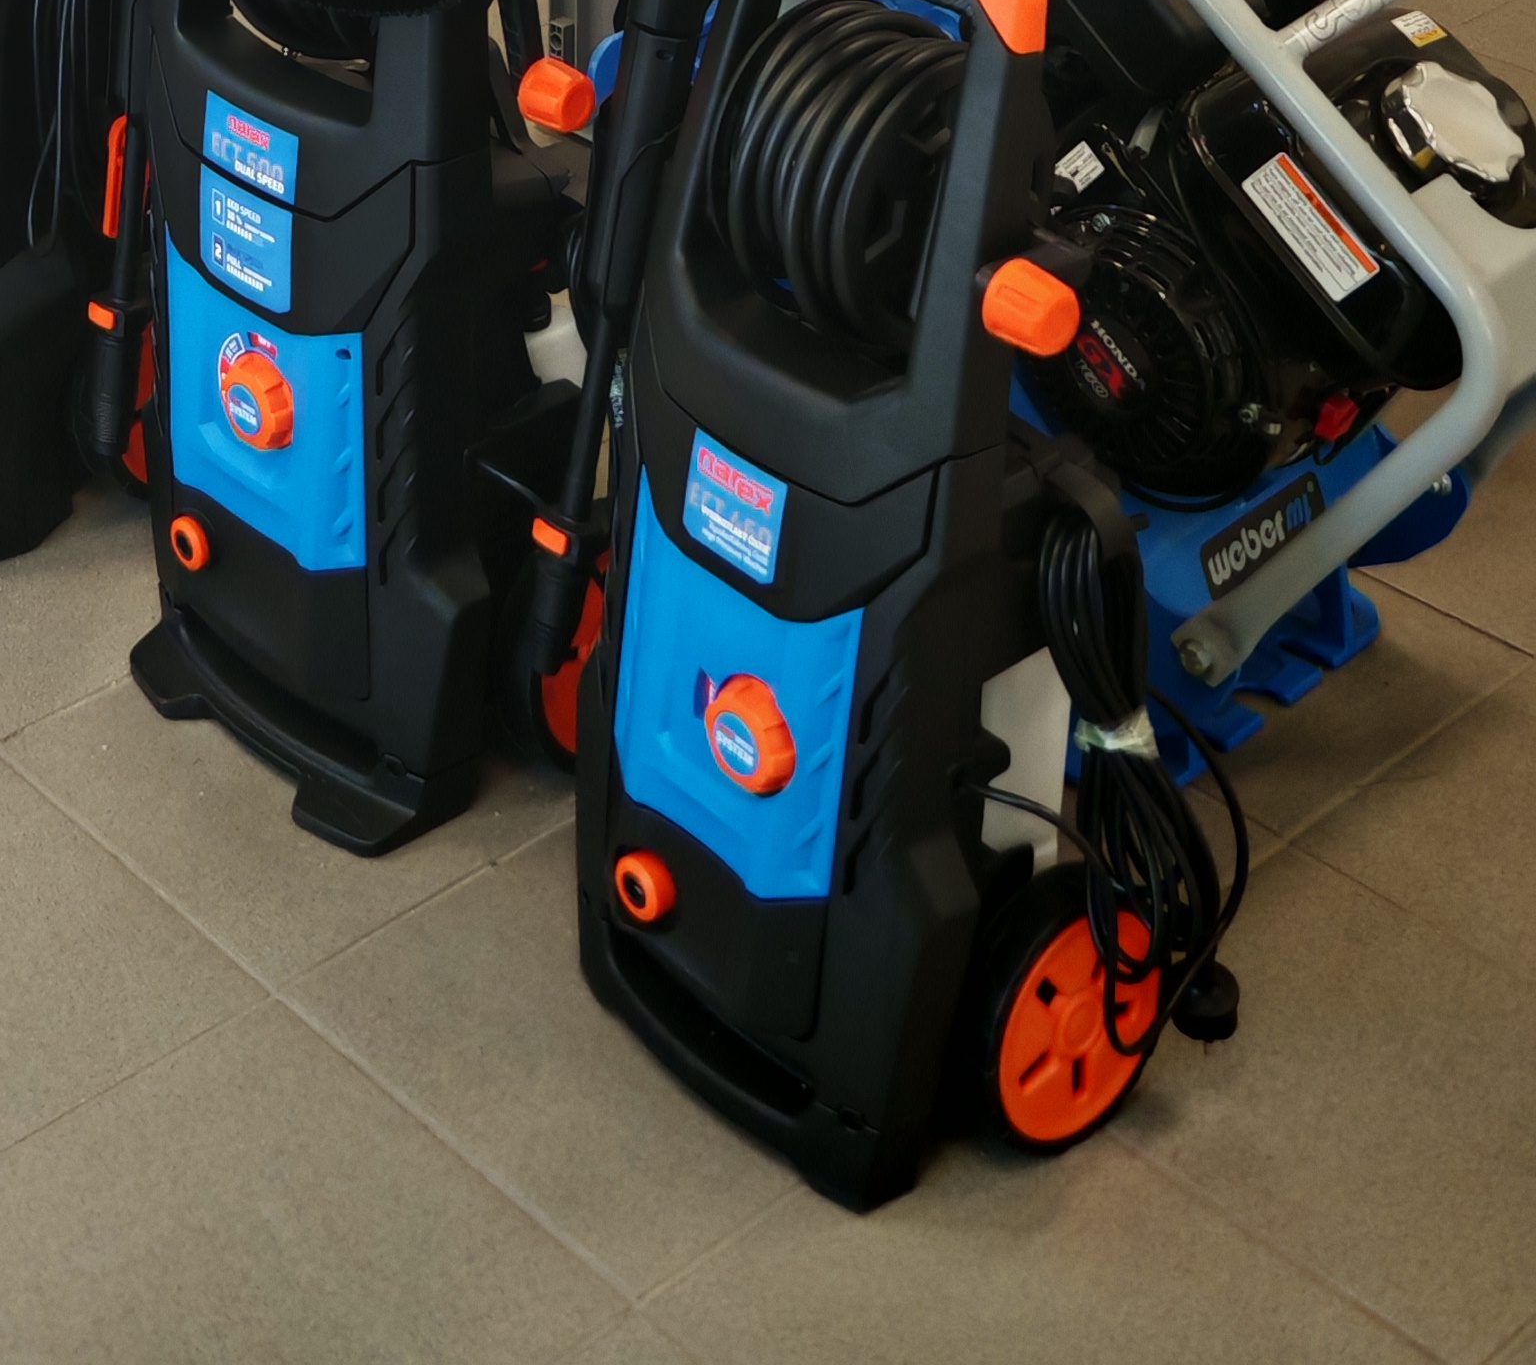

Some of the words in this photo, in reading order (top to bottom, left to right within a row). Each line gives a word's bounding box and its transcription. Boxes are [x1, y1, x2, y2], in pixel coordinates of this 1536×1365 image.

[235, 160, 256, 180] DUAL
[257, 171, 285, 195] SPEED
[214, 199, 221, 216] 1
[214, 243, 222, 261] 2
[1076, 334, 1128, 399] GX
[1089, 319, 1145, 391] HONDA
[697, 446, 774, 515] narex
